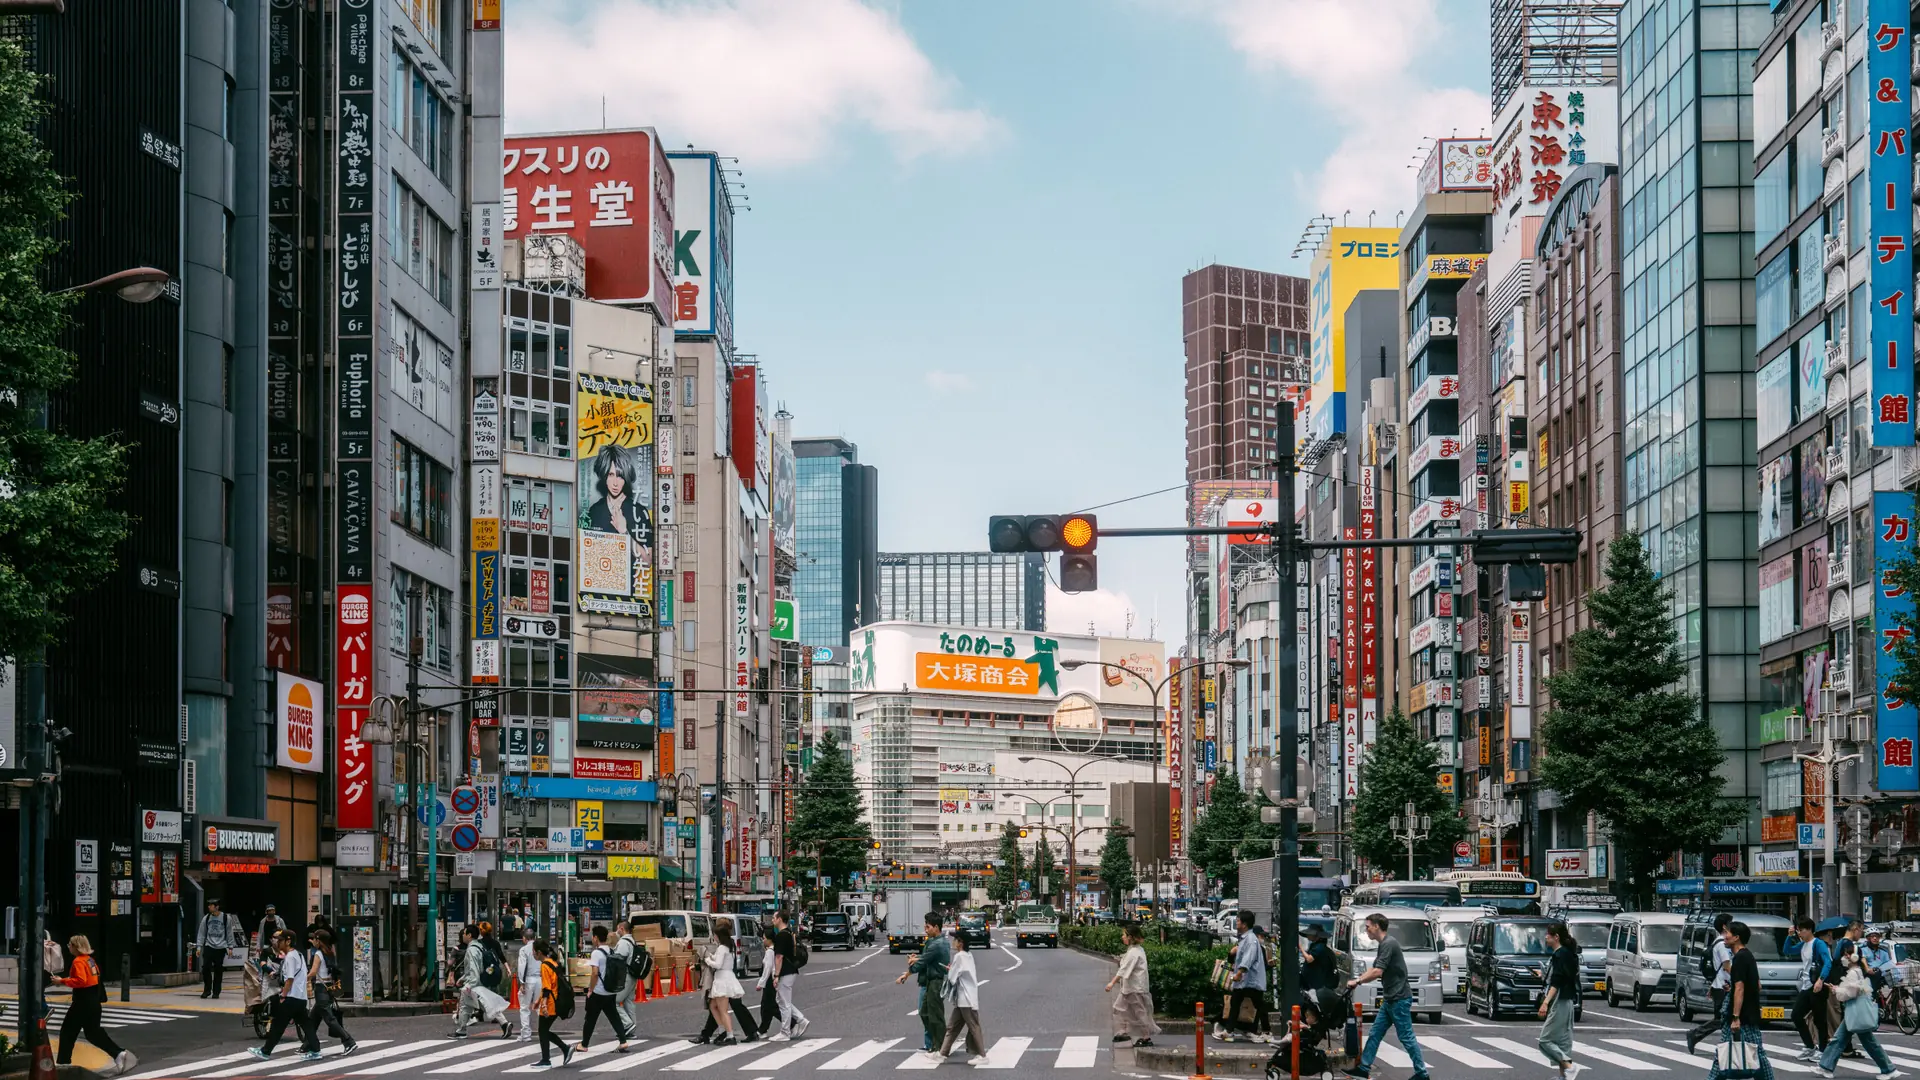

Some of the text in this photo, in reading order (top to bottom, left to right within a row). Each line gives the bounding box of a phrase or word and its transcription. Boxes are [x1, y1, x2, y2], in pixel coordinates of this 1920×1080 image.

[481, 20, 493, 29] 8F
[349, 75, 364, 87] 8F
[349, 198, 364, 209] 7F
[1875, 23, 1909, 424] ケ&パーティー館
[341, 233, 360, 310] ともしび
[480, 277, 493, 286] 5F
[348, 319, 363, 331] 6F
[347, 353, 369, 419] Euphoria
[580, 376, 650, 399] Tokyo Tensei Clinic
[585, 400, 616, 420] 小顔
[602, 410, 642, 429] 整形なら
[348, 442, 363, 454] 5F
[579, 423, 649, 455] テンクリ
[660, 465, 672, 473] 5F
[1364, 468, 1372, 495] 300
[478, 475, 486, 516] ミライザカ
[631, 488, 651, 599] たいせい先生
[347, 565, 363, 577] 4F
[533, 572, 548, 581] トルコ
[341, 602, 369, 610] BURGER
[1346, 528, 1356, 669] KRAOKE & PARTY
[341, 610, 369, 620] KING
[736, 583, 747, 656] 新宿サンパーク
[939, 631, 1016, 659] たのめーる
[481, 641, 490, 675] 博多酒場
[925, 661, 1030, 687] 大塚商会
[736, 661, 748, 712] 三平本館
[1170, 666, 1181, 706] パチンコ
[287, 705, 313, 726] BURGER
[474, 700, 497, 710] DARTS
[478, 709, 493, 718] BAR
[342, 631, 368, 806] バーガーキング
[287, 724, 313, 750] KING
[592, 740, 641, 749] リアエイド ビジョン
[1170, 709, 1182, 768] エスパス
[1346, 713, 1357, 797] PASELA
[576, 760, 615, 772] トルコ料理
[488, 785, 497, 807] NEW
[579, 808, 601, 819] プロ
[1171, 808, 1181, 840] パチンコ
[219, 830, 275, 852] BURGER KING
[573, 830, 581, 841] P
[1803, 826, 1810, 838] P
[581, 860, 600, 870] 囲碁
[613, 863, 650, 873] クリスタル
